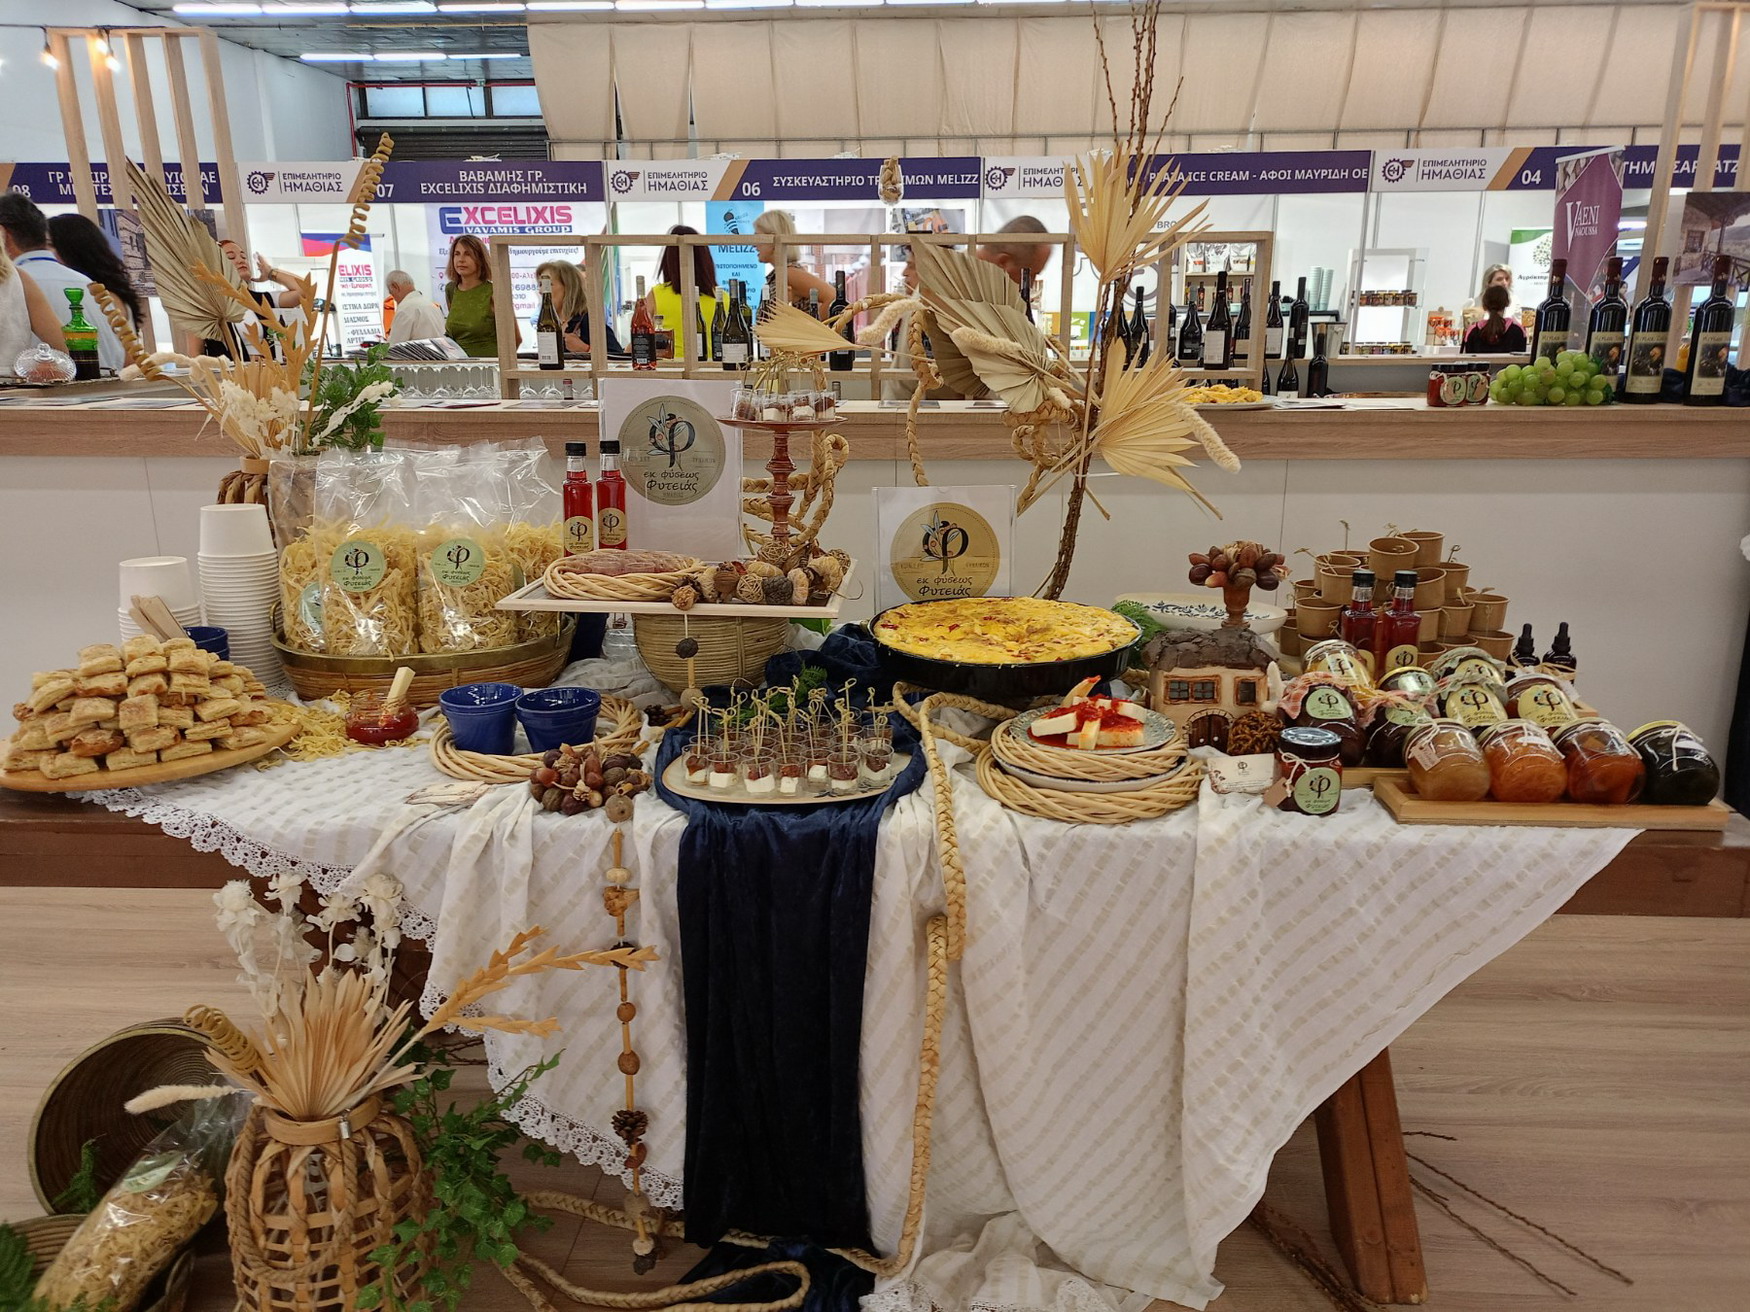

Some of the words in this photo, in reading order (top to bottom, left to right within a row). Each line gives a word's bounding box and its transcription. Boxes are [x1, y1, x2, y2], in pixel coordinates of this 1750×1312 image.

[1422, 159, 1487, 167] ΕΠΙΜΕΛΗΤΗΡΙΟ
[48, 172, 64, 183] ΓΡ
[283, 172, 341, 180] ΕΠΙΜΕΛΗΤΗΡΙΟ
[459, 171, 523, 182] ΒΑΒΑΜΗΣ
[528, 170, 546, 182] ΓΡ.
[648, 171, 707, 179] ΕΠΙΜΕΛΗΤΗΡΙΟ
[1210, 171, 1249, 182] CREAM
[1260, 170, 1292, 181] ΑΦΟΙ
[1295, 169, 1348, 180] ΜΑΥΡΙΔΗ
[1352, 168, 1368, 179] ΟΕ
[1421, 168, 1486, 180] ΗΜΑΘΙΑΣ
[1522, 170, 1541, 185] 04
[284, 181, 343, 192] ΗΜΑΘΙΑΣ
[648, 180, 708, 192] ΗΜΑΘΙΑΣ
[773, 176, 865, 187] ΣΥΣΚΕΥΑΣΤΗΡΙΟ
[868, 174, 934, 187] ΤΡΙΜΩΝ
[937, 174, 979, 185] MELIZZ
[1023, 176, 1083, 188] ΗΜΑΘΣ
[376, 184, 394, 197] 07
[420, 183, 484, 194] EXCELIXIS
[488, 183, 587, 194] ΔΙΑΦΗΜΙΣΤΙΚΗ
[742, 182, 761, 196] 06
[439, 205, 572, 234] EXCELIXIS
[1566, 201, 1600, 253] VAENI
[1575, 226, 1598, 236] NAOUSSA
[338, 264, 372, 276] ELIXIS
[660, 469, 700, 481] φύσεως
[646, 480, 698, 493] Φυτειάς
[933, 575, 973, 586] φύσεως
[919, 585, 971, 597] Φυτειάς
